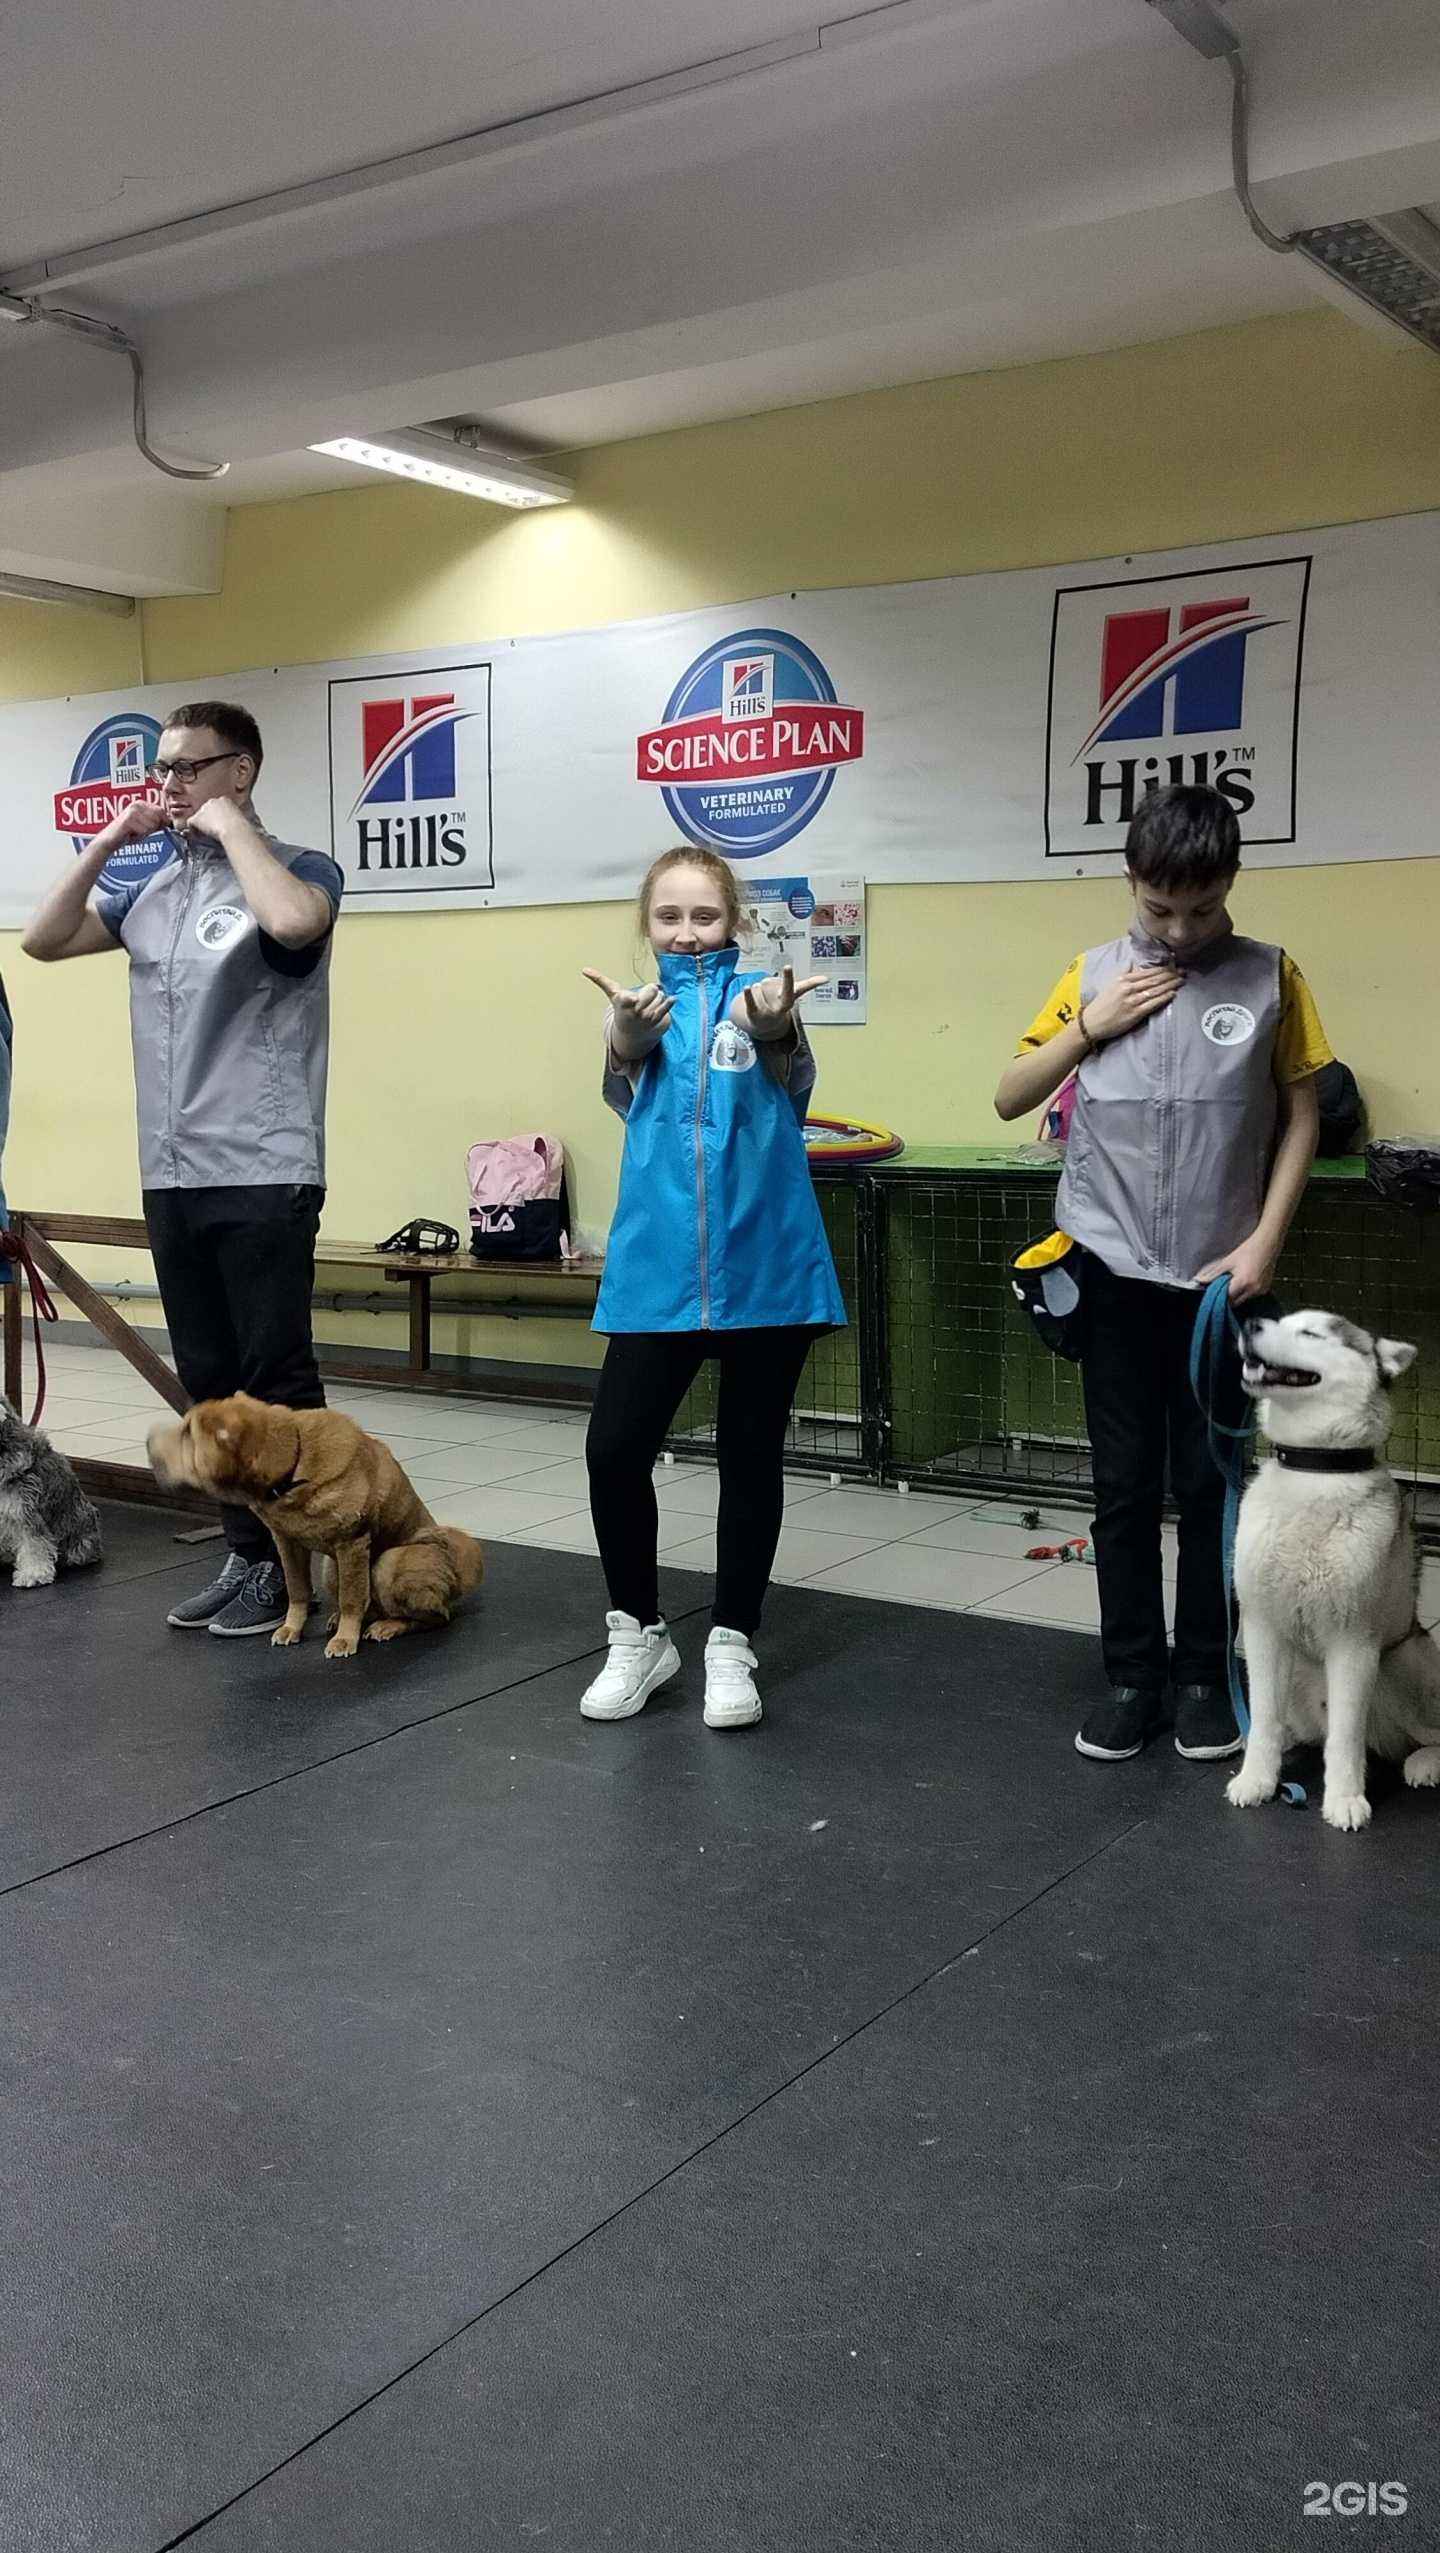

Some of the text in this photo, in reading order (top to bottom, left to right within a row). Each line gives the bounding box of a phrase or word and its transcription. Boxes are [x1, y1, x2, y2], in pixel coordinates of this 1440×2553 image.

[730, 697, 766, 716] Hill's
[646, 720, 851, 774] SCIENCE PLAN
[700, 786, 794, 809] VETERINARY
[708, 802, 786, 820] FORMULATED
[355, 813, 467, 870] Hill's
